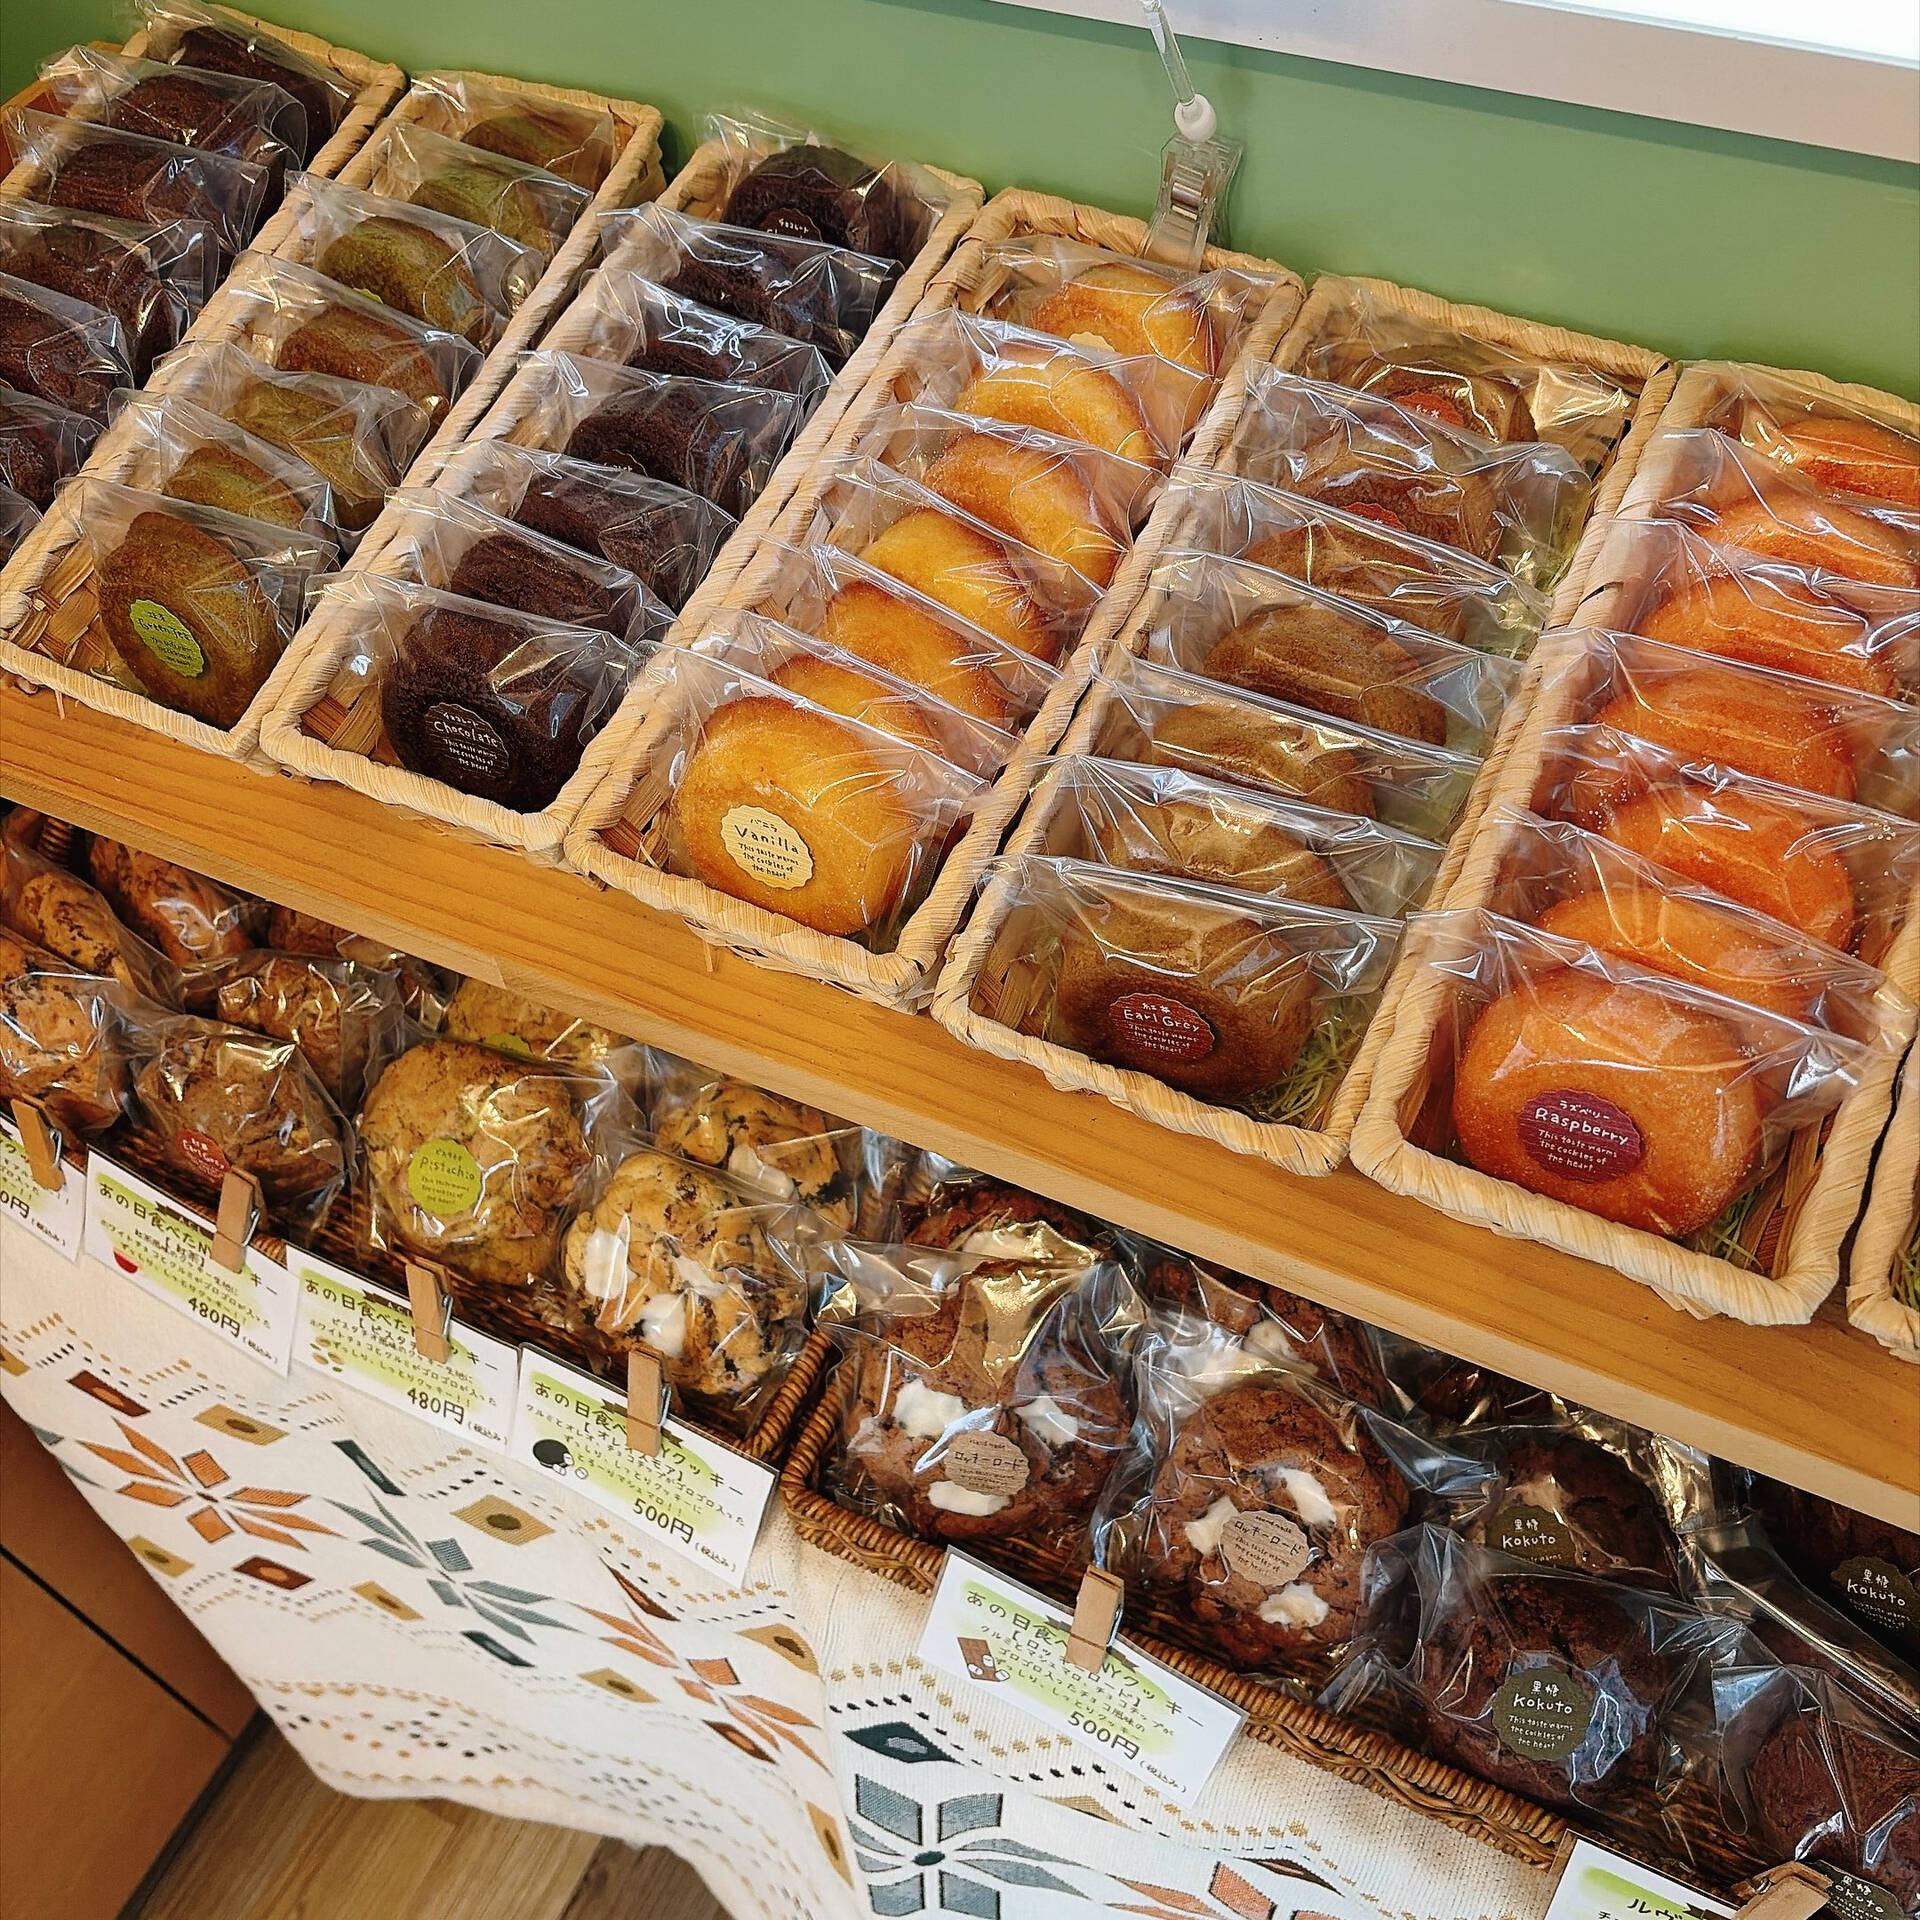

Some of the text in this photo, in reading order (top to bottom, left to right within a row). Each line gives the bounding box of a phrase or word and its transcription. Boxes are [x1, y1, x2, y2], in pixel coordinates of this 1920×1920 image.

[434, 722, 497, 747] Chocolate
[735, 825, 798, 854] Vanilla
[1124, 1009, 1199, 1032] Earl Grey
[1560, 1100, 1610, 1120] ラズベリー
[1535, 1108, 1628, 1145] Raspberry
[1538, 1129, 1617, 1158] This taste warms
[1540, 1141, 1555, 1150] the
[1597, 1156, 1607, 1165] of
[420, 1157, 475, 1180] Pistachio
[1548, 1154, 1563, 1163] the
[188, 1297, 240, 1338] 480円
[408, 1388, 464, 1424] 480円
[633, 1498, 693, 1544] 500円
[1235, 1521, 1304, 1556] ロッキーロード
[1502, 1533, 1556, 1549] Kokuto
[1847, 1579, 1906, 1606] Kokuto
[1513, 1693, 1573, 1715] Kokuto
[1509, 1715, 1526, 1724] This
[1068, 1711, 1140, 1760] 500円
[1835, 1884, 1884, 1912] okuto
